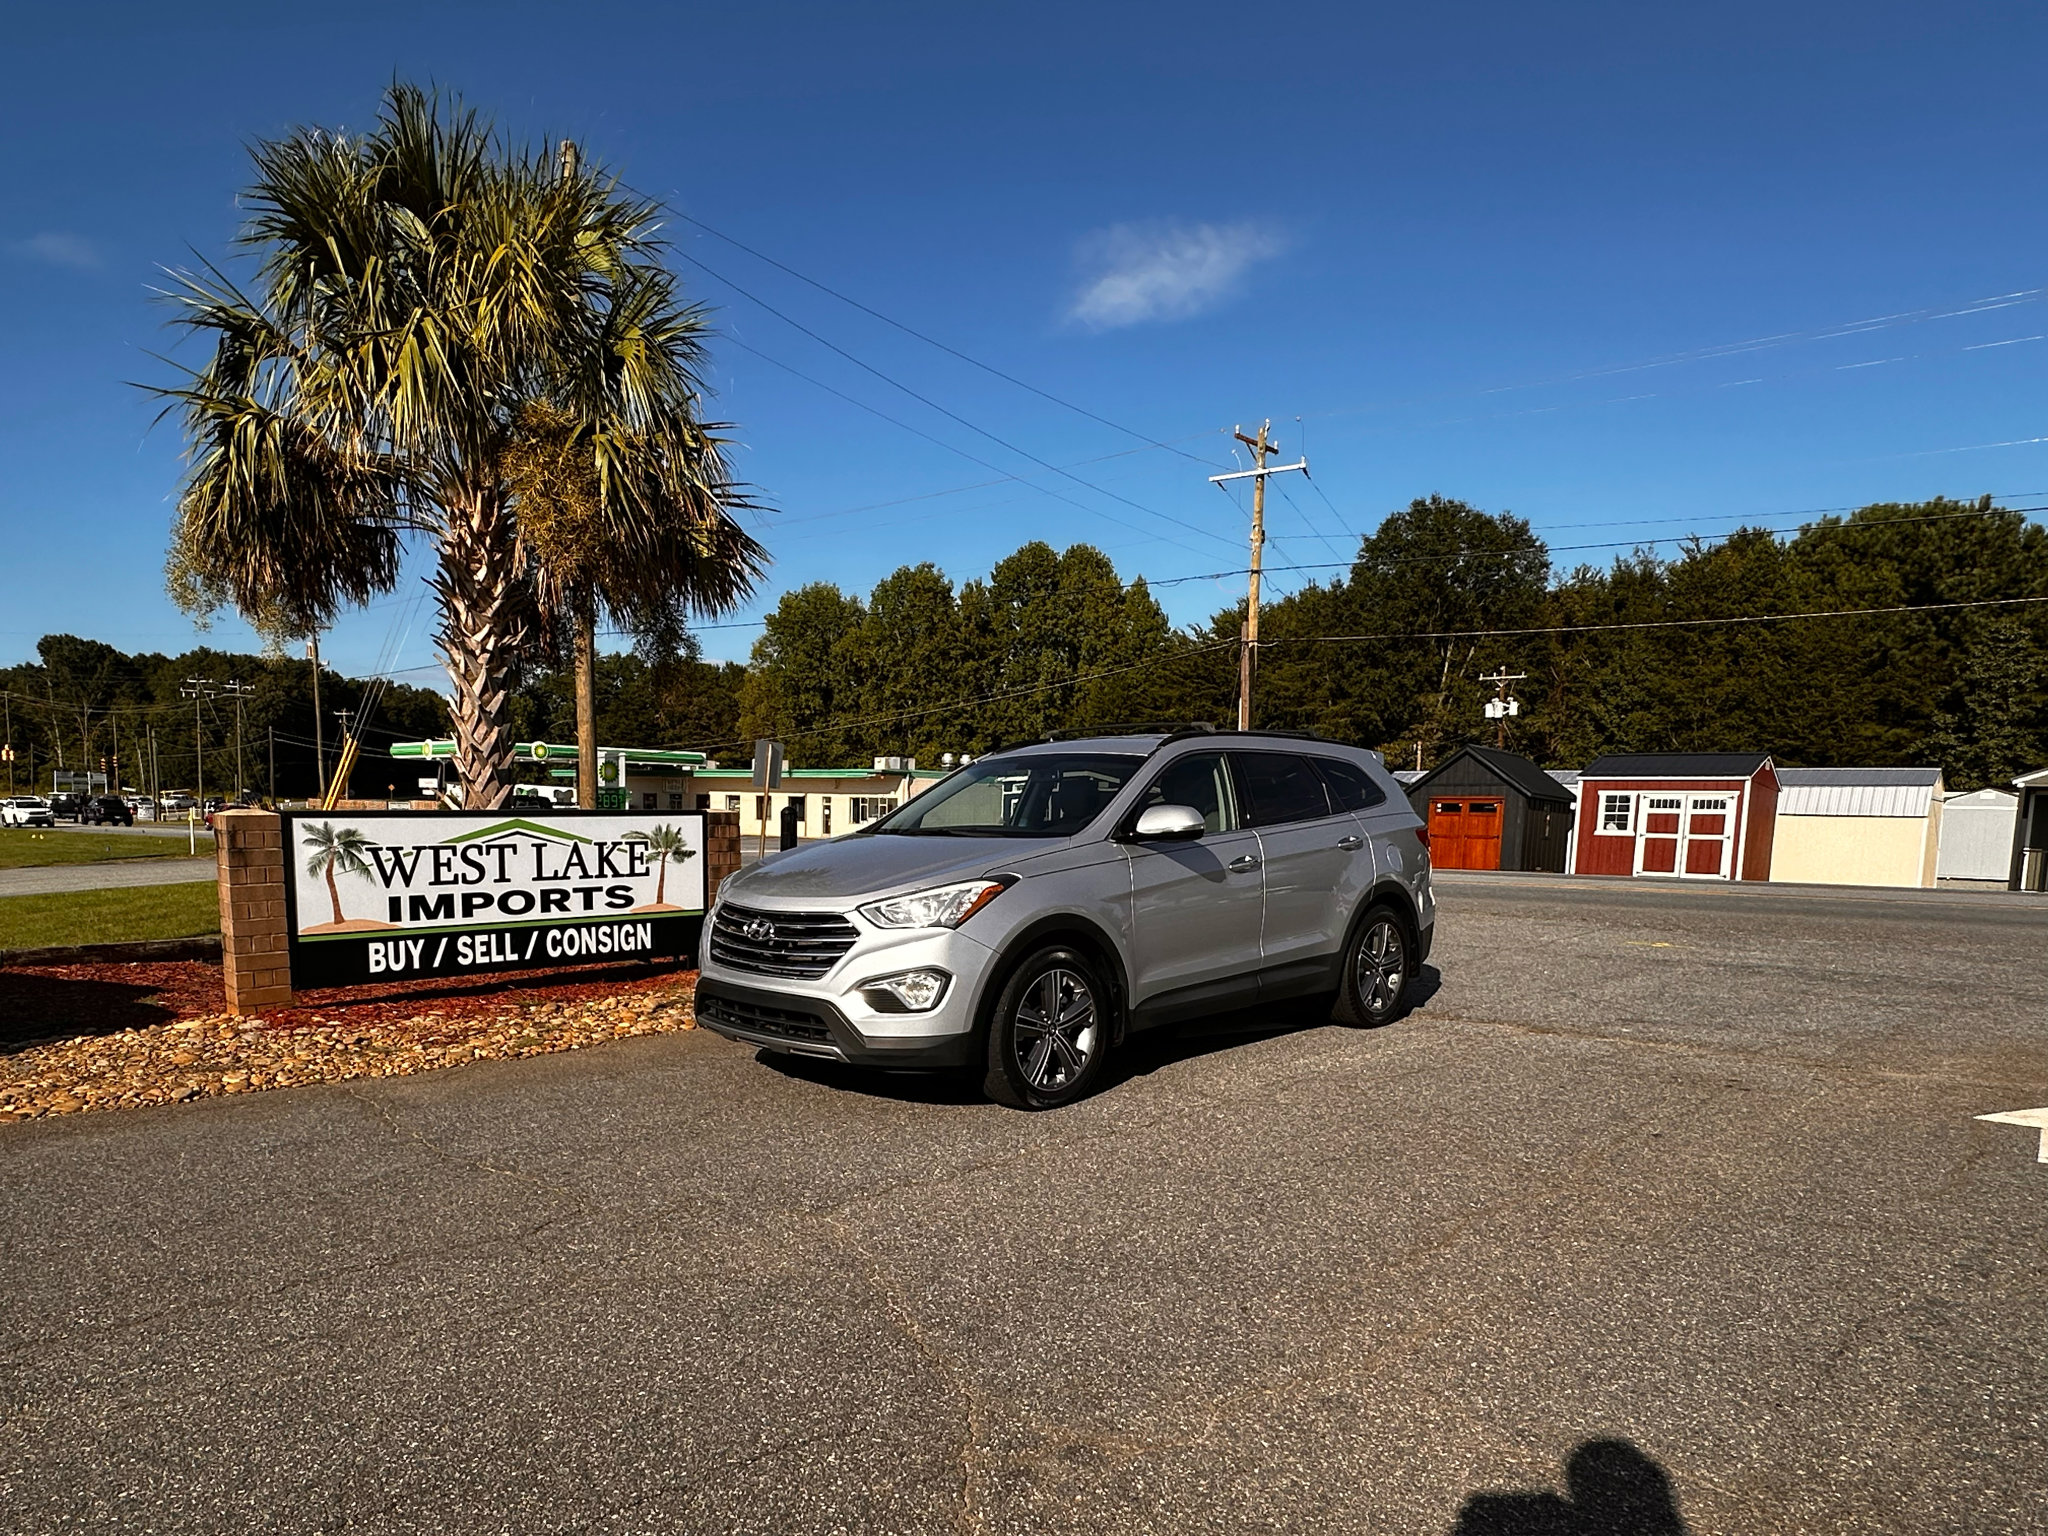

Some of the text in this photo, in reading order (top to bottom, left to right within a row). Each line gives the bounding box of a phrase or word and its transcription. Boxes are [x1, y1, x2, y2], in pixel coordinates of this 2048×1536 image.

[364, 840, 650, 889] WEST LAKE
[388, 884, 635, 922] IMPORTS
[368, 938, 425, 973] BUY
[456, 932, 519, 966] SELL
[546, 922, 652, 958] CONSIGN
